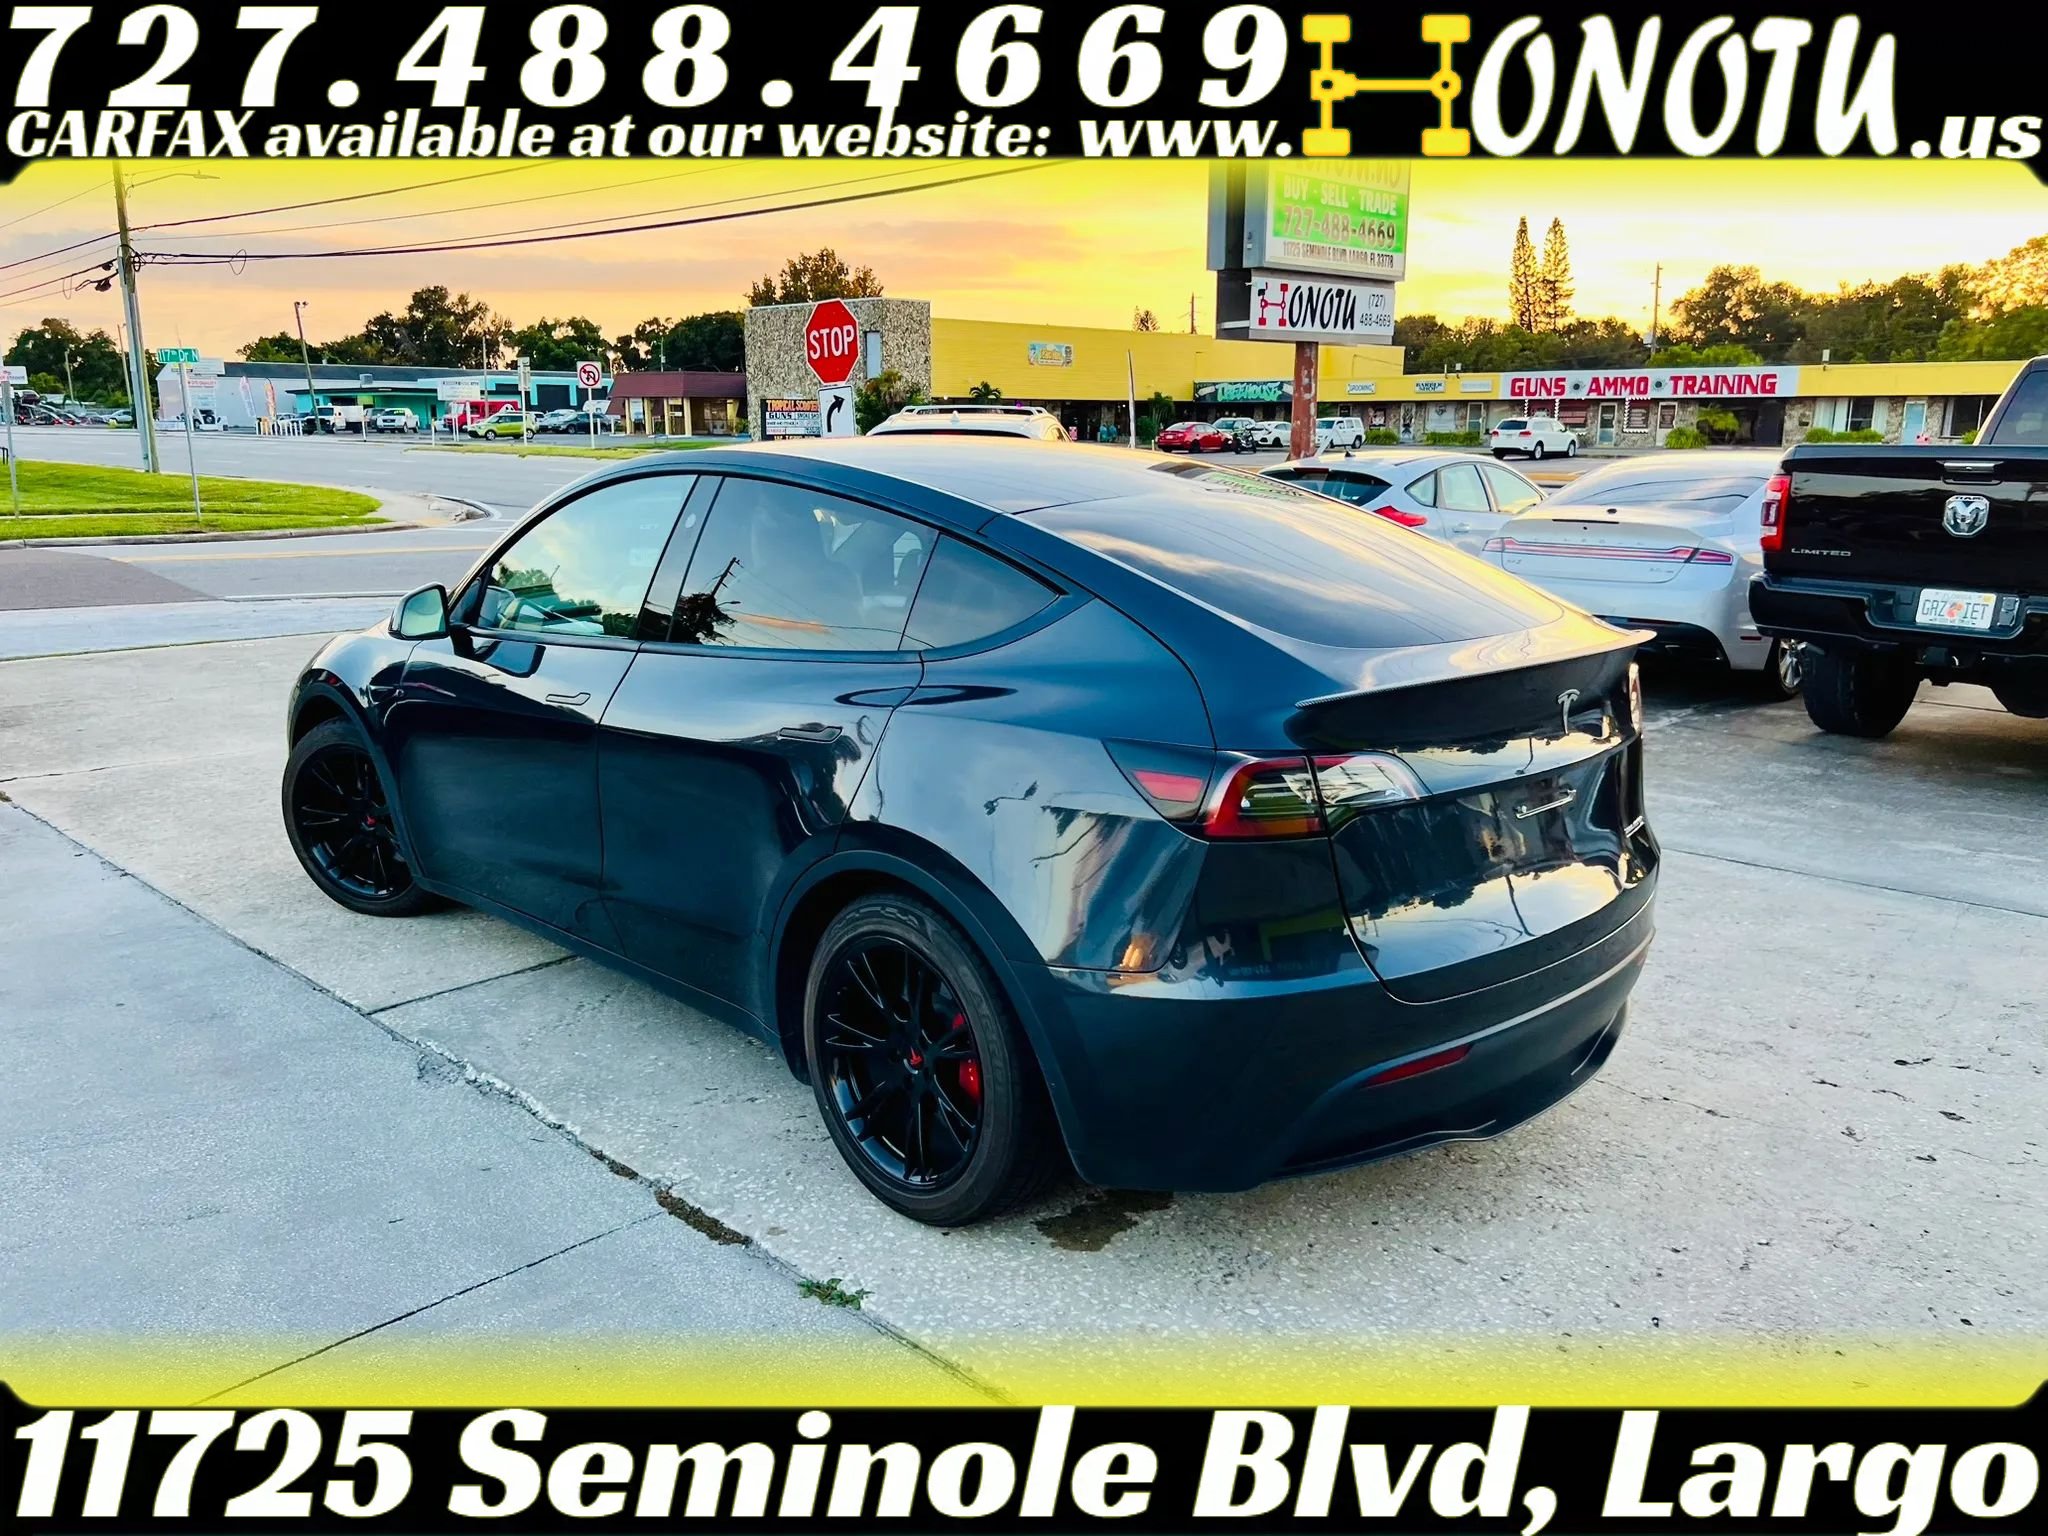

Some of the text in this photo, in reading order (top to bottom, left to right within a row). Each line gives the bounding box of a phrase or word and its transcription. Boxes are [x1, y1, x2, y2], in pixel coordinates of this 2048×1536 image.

[1283, 174, 1398, 216] BUY SELL TRADE
[1282, 204, 1396, 250] 727-488-4669
[1368, 294, 1386, 310] (727)
[1359, 312, 1392, 329] 488-4669
[809, 324, 855, 360] STOP
[1510, 373, 1778, 397] GUNS AMMO TRAINING
[769, 412, 792, 420] GUNS
[1791, 548, 1851, 557] LIMITED
